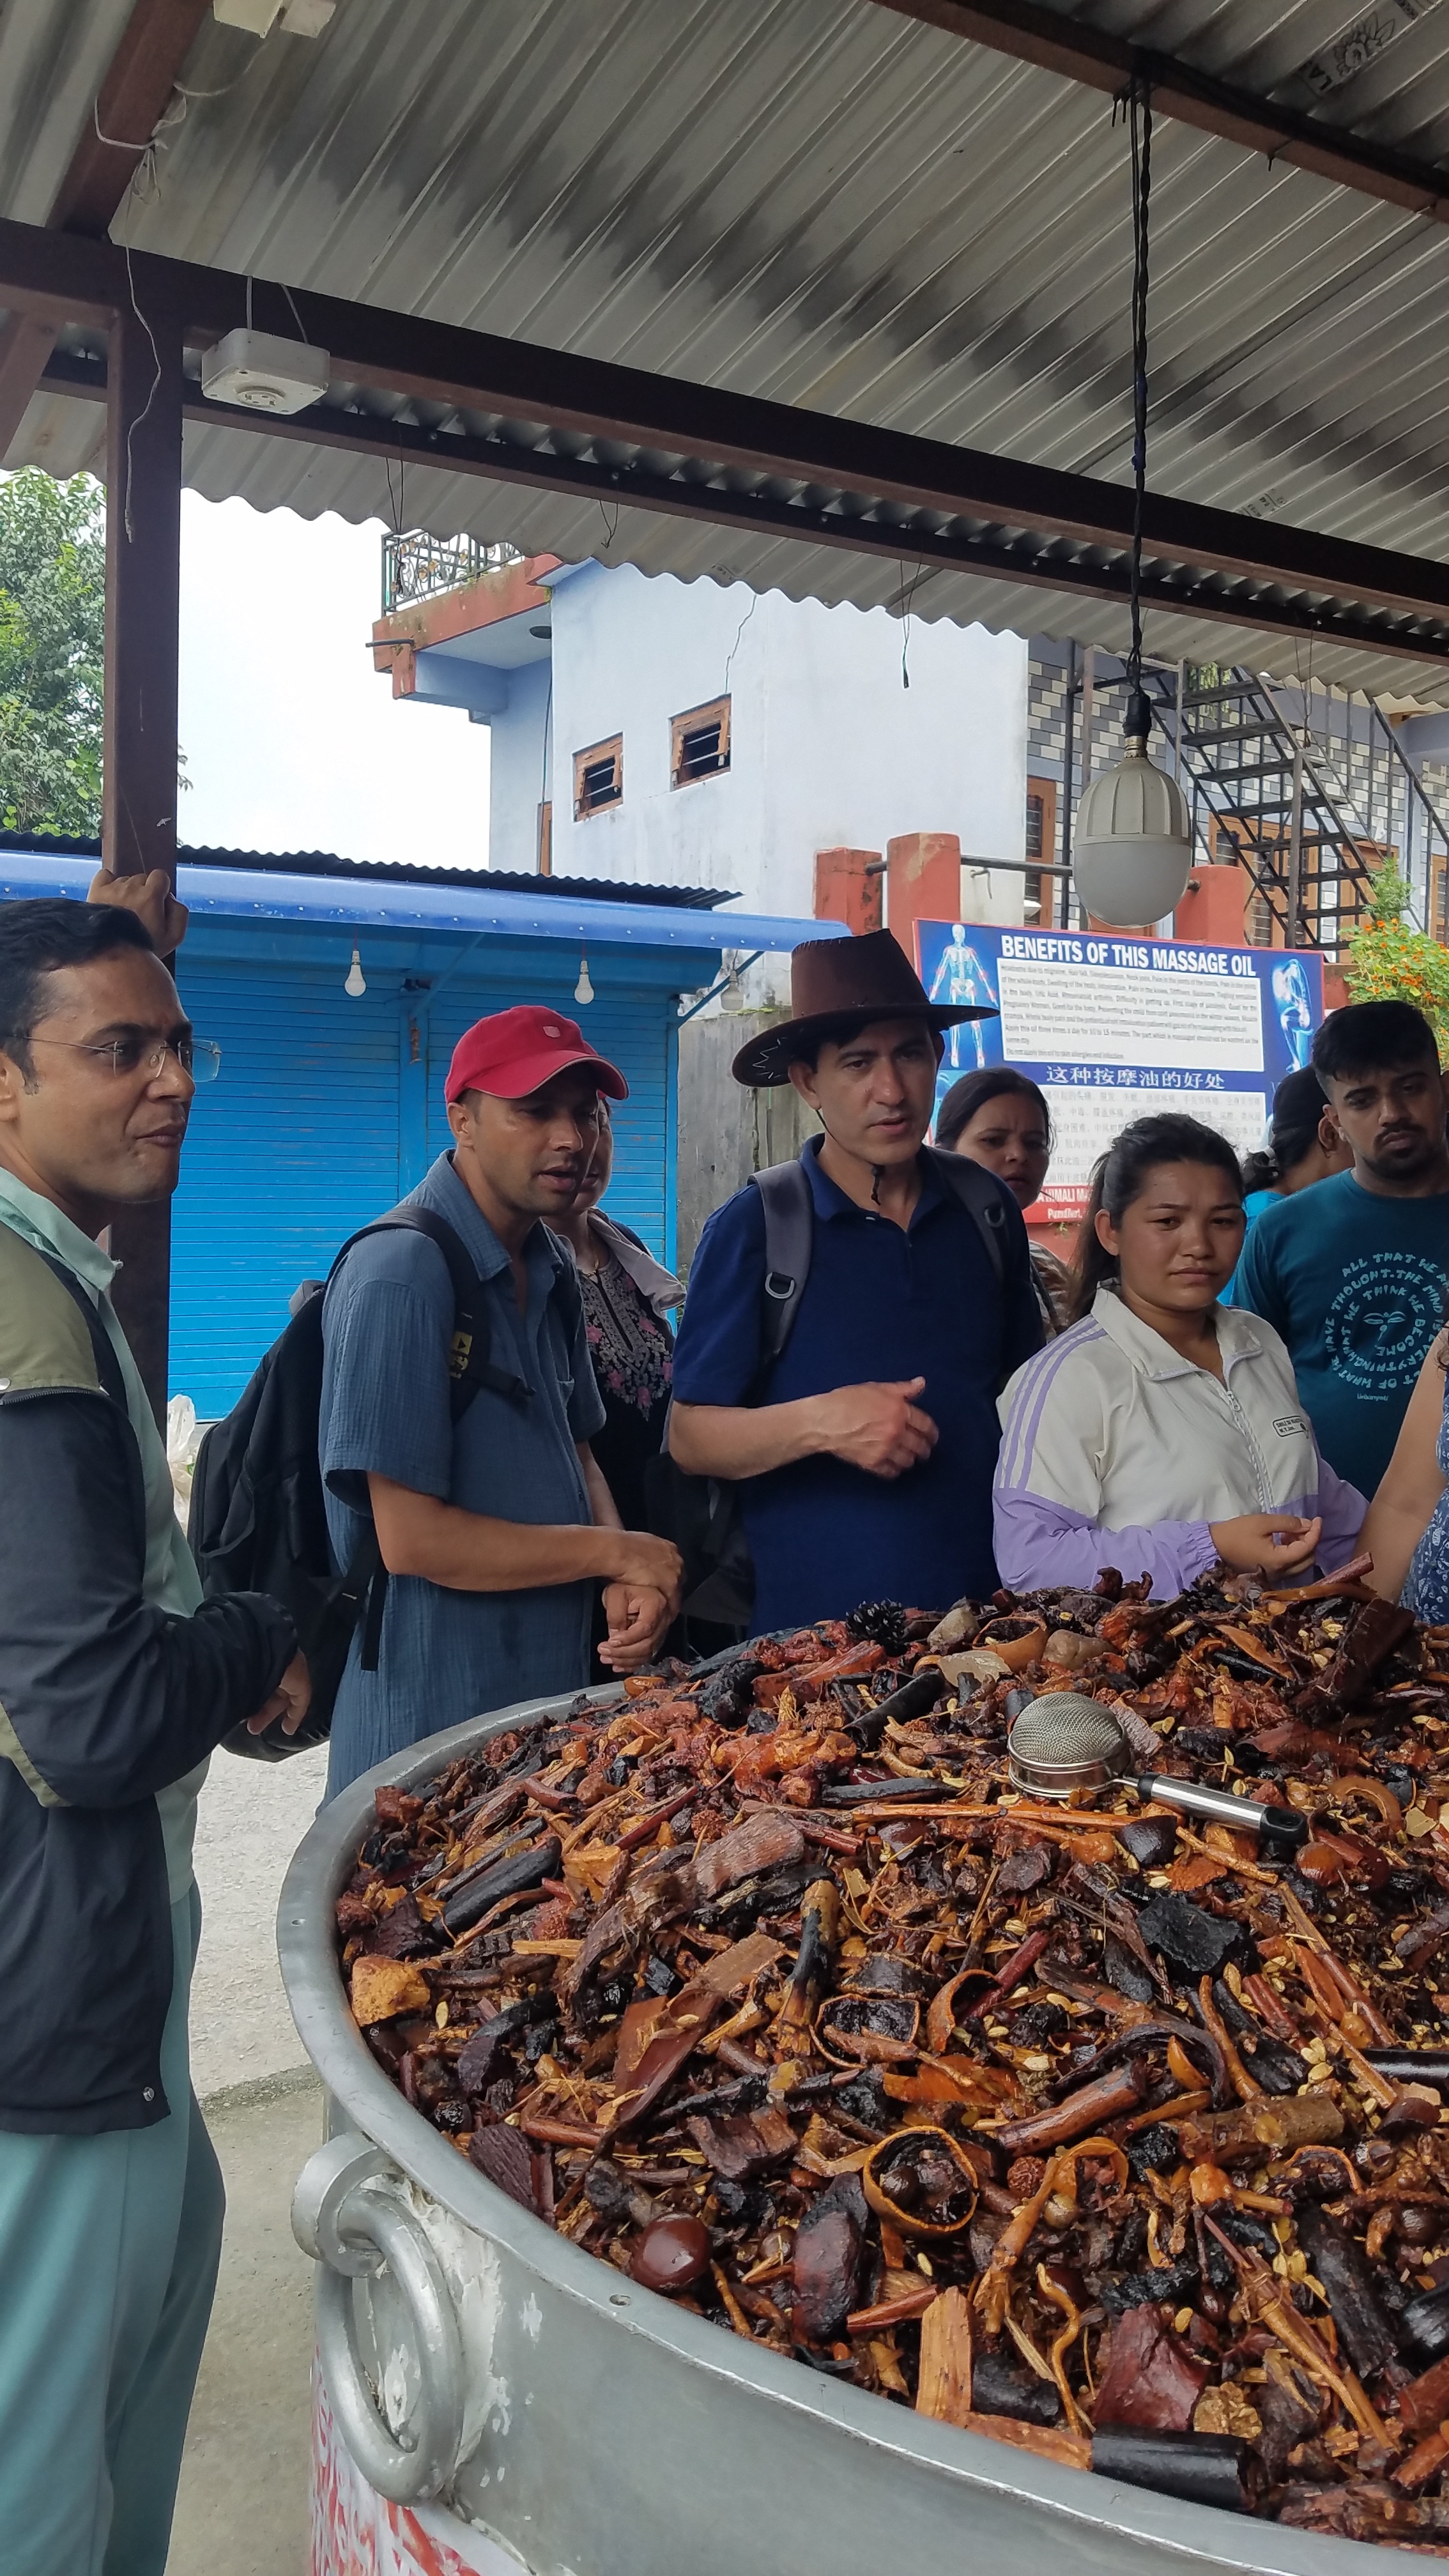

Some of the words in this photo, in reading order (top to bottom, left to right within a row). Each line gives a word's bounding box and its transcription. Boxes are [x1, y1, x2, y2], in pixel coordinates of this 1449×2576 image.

[1001, 935, 1082, 963] BENEFITS
[1086, 942, 1108, 963] OF
[1112, 944, 1149, 969] THIS
[1152, 947, 1228, 974] MASSAGE
[1232, 955, 1256, 976] OIL
[1046, 1066, 1225, 1089] 这种按摩油的好处
[1342, 1259, 1367, 1277] ALL
[1373, 1252, 1416, 1263] THAT
[1418, 1259, 1438, 1273] WE
[1396, 1269, 1424, 1285] THE
[1344, 1301, 1360, 1321] WE
[1363, 1285, 1407, 1301] THINK
[1408, 1294, 1425, 1313] WE
[1422, 1285, 1444, 1314] MIND
[1325, 1317, 1337, 1352] HAVE
[1338, 1369, 1372, 1388] WHAT
[1378, 1378, 1397, 1390] OF
